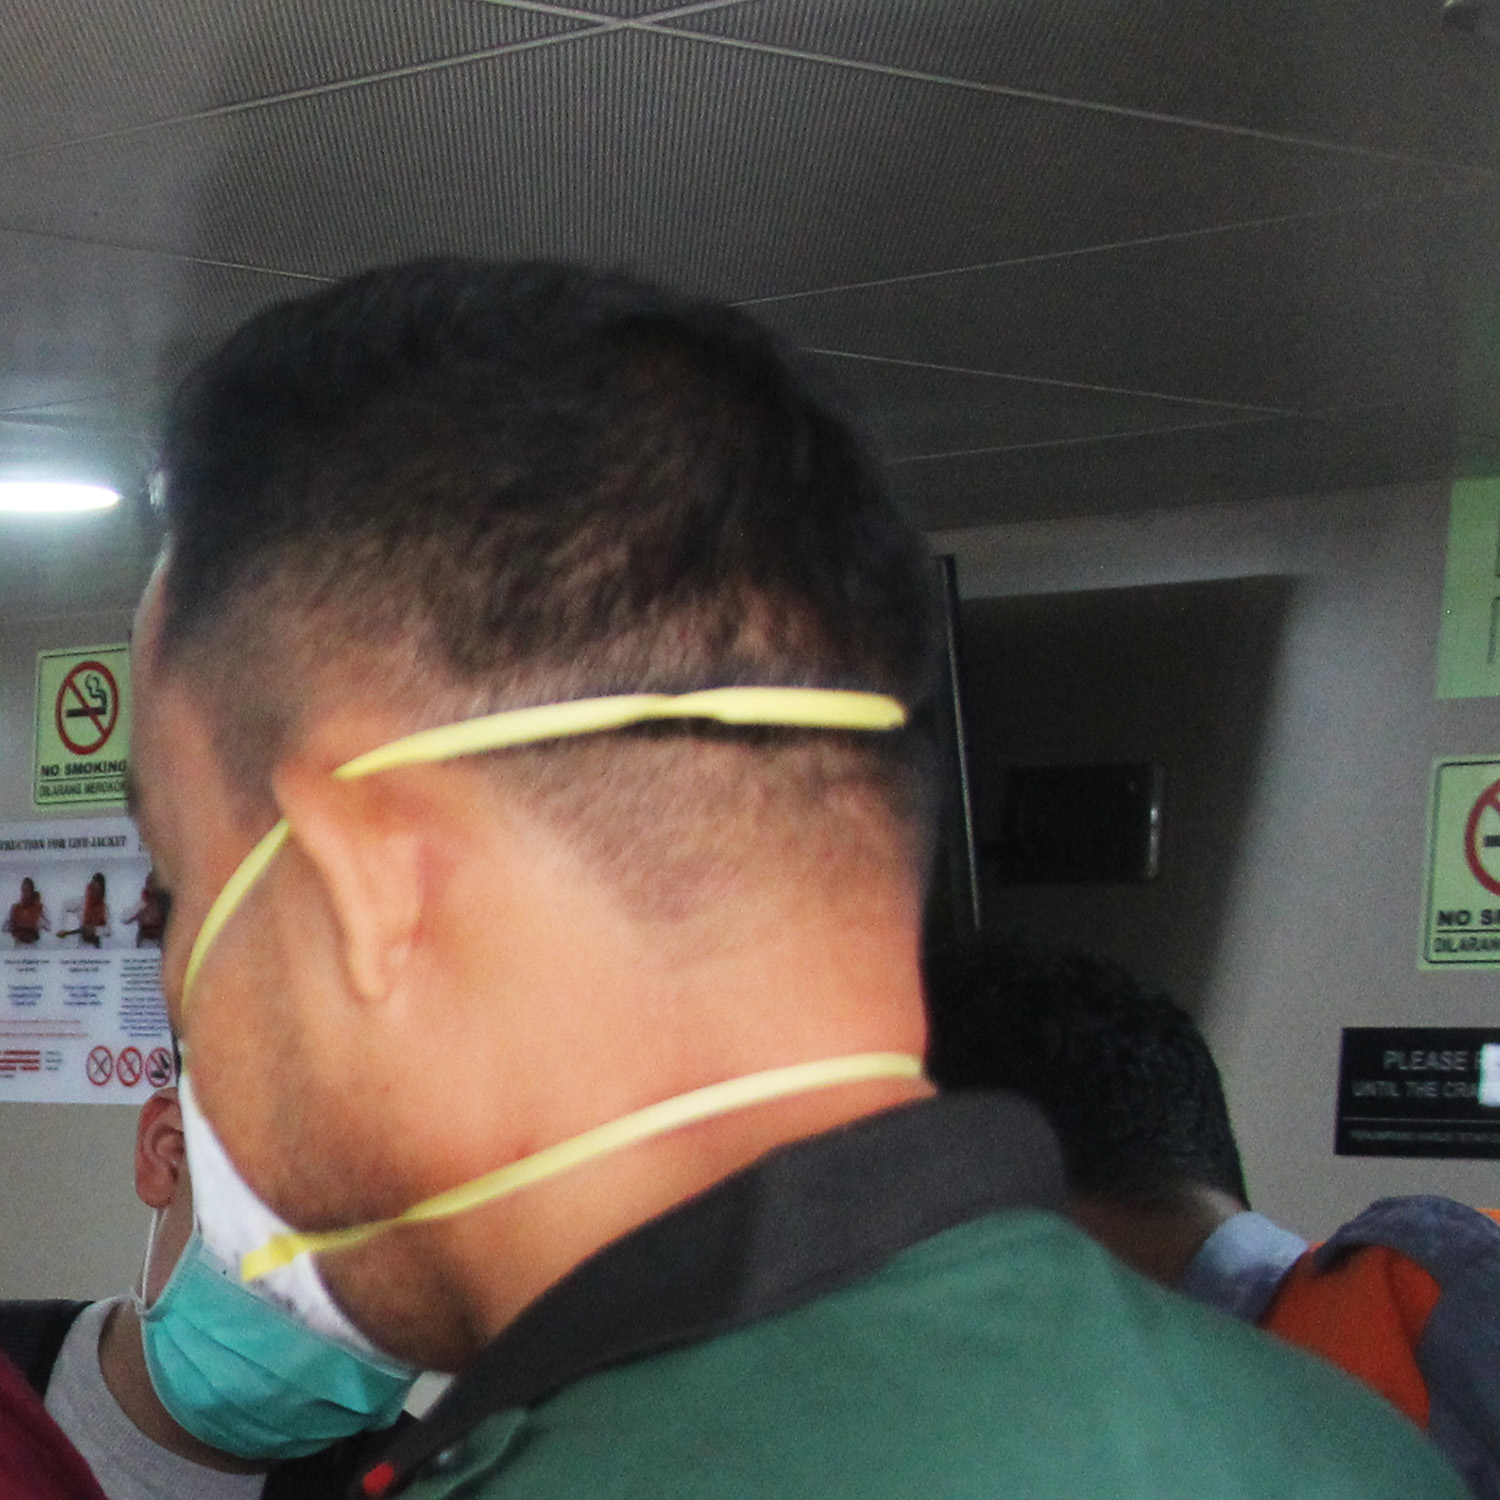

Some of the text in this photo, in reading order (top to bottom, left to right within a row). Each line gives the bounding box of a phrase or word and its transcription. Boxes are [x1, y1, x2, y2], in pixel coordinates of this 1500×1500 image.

[40, 764, 60, 776] NO
[1437, 910, 1471, 926] NO
[1384, 1050, 1467, 1071] PLEASE
[1405, 1081, 1439, 1097] THE
